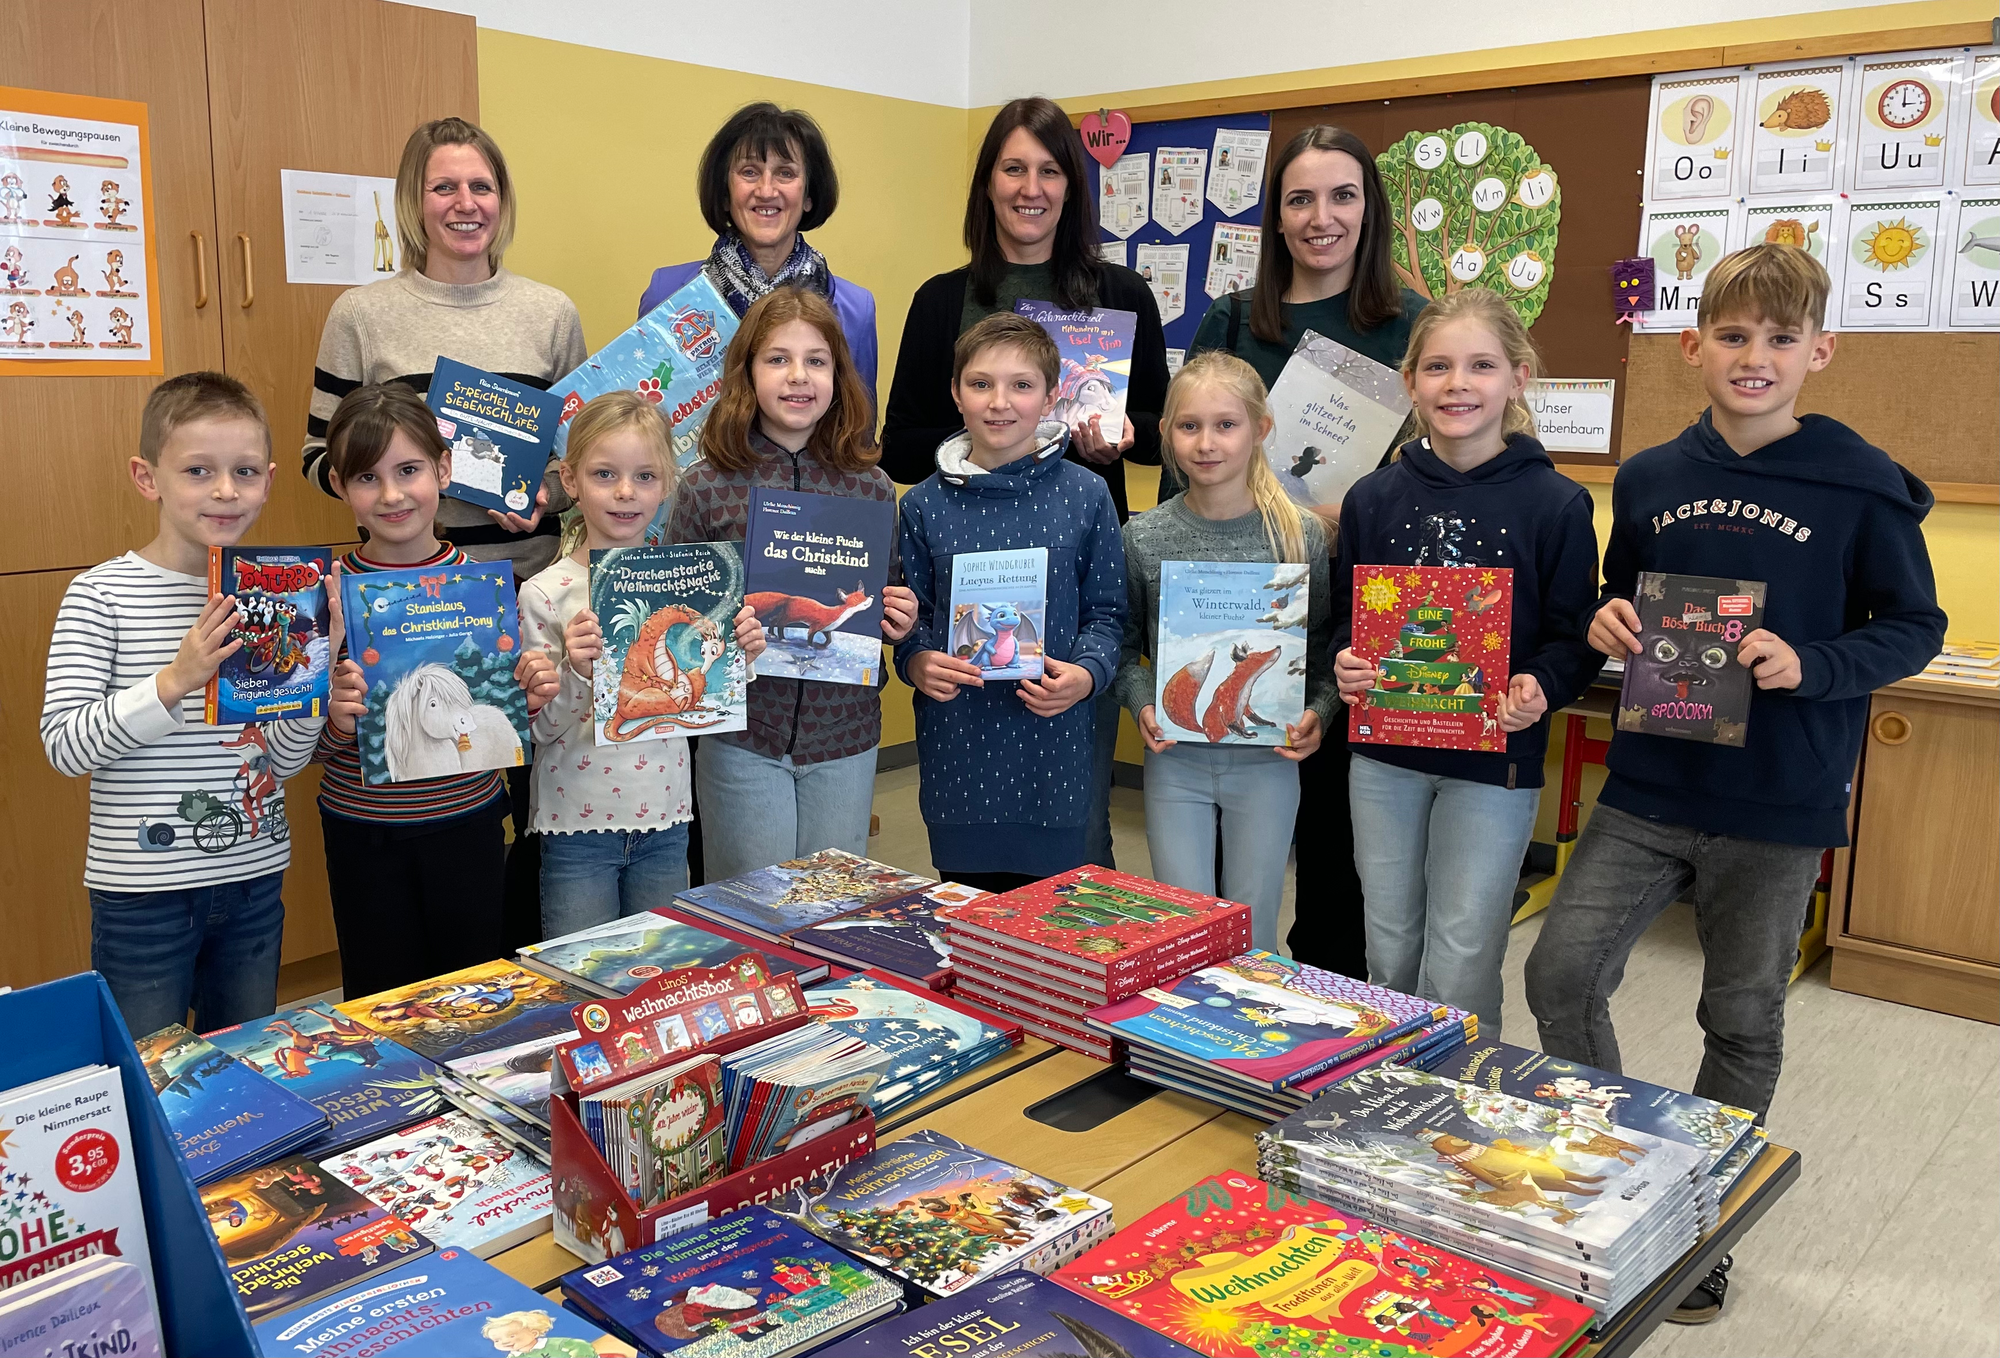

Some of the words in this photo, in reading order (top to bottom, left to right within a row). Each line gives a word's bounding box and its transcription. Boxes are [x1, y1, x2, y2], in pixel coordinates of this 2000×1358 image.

[32, 123, 121, 142] Bewegungspausen
[690, 335, 717, 357] PATROL
[1069, 334, 1091, 345] Esel
[1098, 337, 1122, 351] Finn
[454, 381, 510, 409] STREICHEL
[514, 402, 541, 419] DEN
[1329, 393, 1350, 411] Was
[1534, 399, 1573, 414] Unser
[445, 392, 539, 432] SIEBENSCHLÄFER
[1302, 402, 1344, 425] glitzert
[1343, 419, 1357, 433] da
[1299, 415, 1311, 426] im
[1312, 421, 1350, 445] Schnee?
[1538, 419, 1604, 435] tabenbaum
[1718, 523, 1755, 535] MCMXC
[773, 530, 789, 540] Wie
[790, 532, 804, 542] der
[805, 532, 834, 545] kleine
[836, 535, 864, 549] Fuchs
[695, 549, 711, 557] Reich
[764, 542, 788, 559] das
[792, 546, 869, 568] Christkind
[620, 560, 714, 580] Drachenstarke
[804, 566, 826, 576] sucht
[963, 560, 986, 573] SOPHIE
[988, 558, 1035, 571] WINDGRUBER
[959, 577, 994, 587] Lucyus
[997, 573, 1038, 584] Rettung
[1199, 587, 1221, 596] glitzert
[405, 600, 466, 615] Stanislaus,
[1192, 598, 1266, 612] Winterwald,
[1418, 610, 1443, 620] EINE
[1684, 602, 1707, 615] Das
[382, 627, 397, 636] das
[400, 615, 493, 635] Christkind-Pony
[1661, 615, 1689, 631] Böse
[1695, 620, 1726, 634] Buch
[1724, 619, 1743, 642] 8
[1409, 637, 1447, 649] FROHE
[1404, 664, 1450, 681] Disney
[233, 689, 271, 701] Pinguine
[273, 684, 313, 698] gesucht!
[235, 678, 268, 689] Sieben
[1385, 696, 1466, 710] WEIHNACHT
[1118, 959, 1136, 971] Disney
[657, 973, 689, 991] Linos
[1118, 975, 1135, 988] Disney
[621, 978, 735, 1024] Weihnachtsbox
[1148, 1012, 1232, 1046] Geschichten
[1187, 1016, 1258, 1043] Christkind
[1230, 1042, 1268, 1058] 24
[15, 1112, 36, 1126] Die
[38, 1101, 72, 1118] kleine
[74, 1089, 109, 1107] Raupe
[43, 1105, 112, 1134] Nimmersatt
[62, 1132, 106, 1155] Sonderpreis
[836, 1148, 951, 1202] Weihnachtszeit
[845, 1168, 877, 1187] Meine
[874, 1151, 918, 1173] fröhliche
[0, 1209, 69, 1261] OHE
[340, 1218, 394, 1244] Spielfiguren
[361, 1232, 375, 1243] 12
[1145, 1218, 1178, 1239] Usborne
[639, 1249, 665, 1263] Die
[667, 1232, 709, 1252] kleine
[709, 1215, 755, 1236] Raupe
[665, 1227, 753, 1264] Nimmersatt
[697, 1250, 719, 1262] und
[720, 1240, 739, 1253] der
[1190, 1236, 1333, 1304] Weihnachten
[271, 1275, 302, 1291] Die
[1320, 1293, 1334, 1303] aus
[1334, 1278, 1351, 1296] aller
[1347, 1266, 1364, 1286] Welt
[1272, 1276, 1338, 1314] Traditionen
[0, 1325, 47, 1352] lorence
[50, 1301, 101, 1329] Dailleux
[294, 1316, 366, 1354] Meine
[369, 1287, 447, 1318] ersten
[901, 1334, 923, 1347] Ich
[921, 1327, 940, 1339] bin
[939, 1320, 957, 1331] der
[955, 1308, 985, 1325] kleine
[909, 1315, 1022, 1358] ESEL
[988, 1341, 1006, 1354] der
